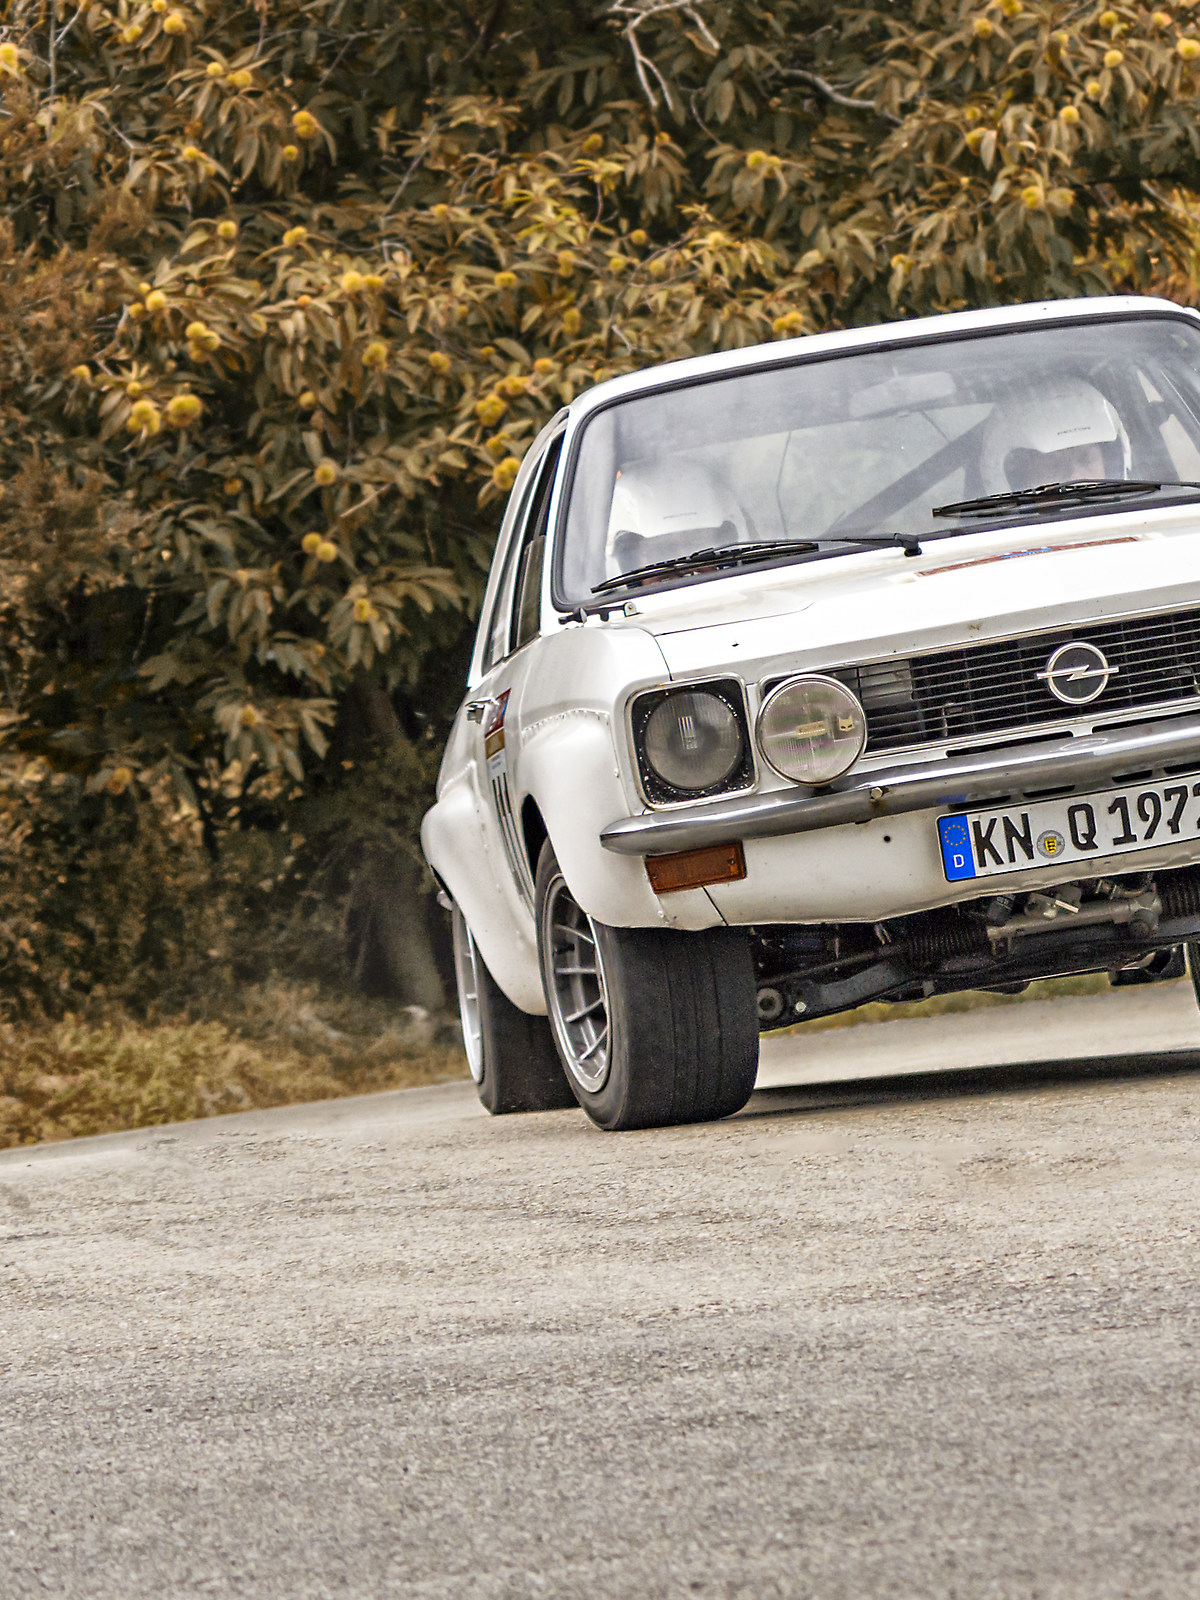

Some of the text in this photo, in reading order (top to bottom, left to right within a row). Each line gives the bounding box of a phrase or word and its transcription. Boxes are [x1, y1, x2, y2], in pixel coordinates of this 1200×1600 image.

[972, 813, 1035, 868] KN
[1067, 803, 1099, 852] Q
[953, 853, 965, 868] D
